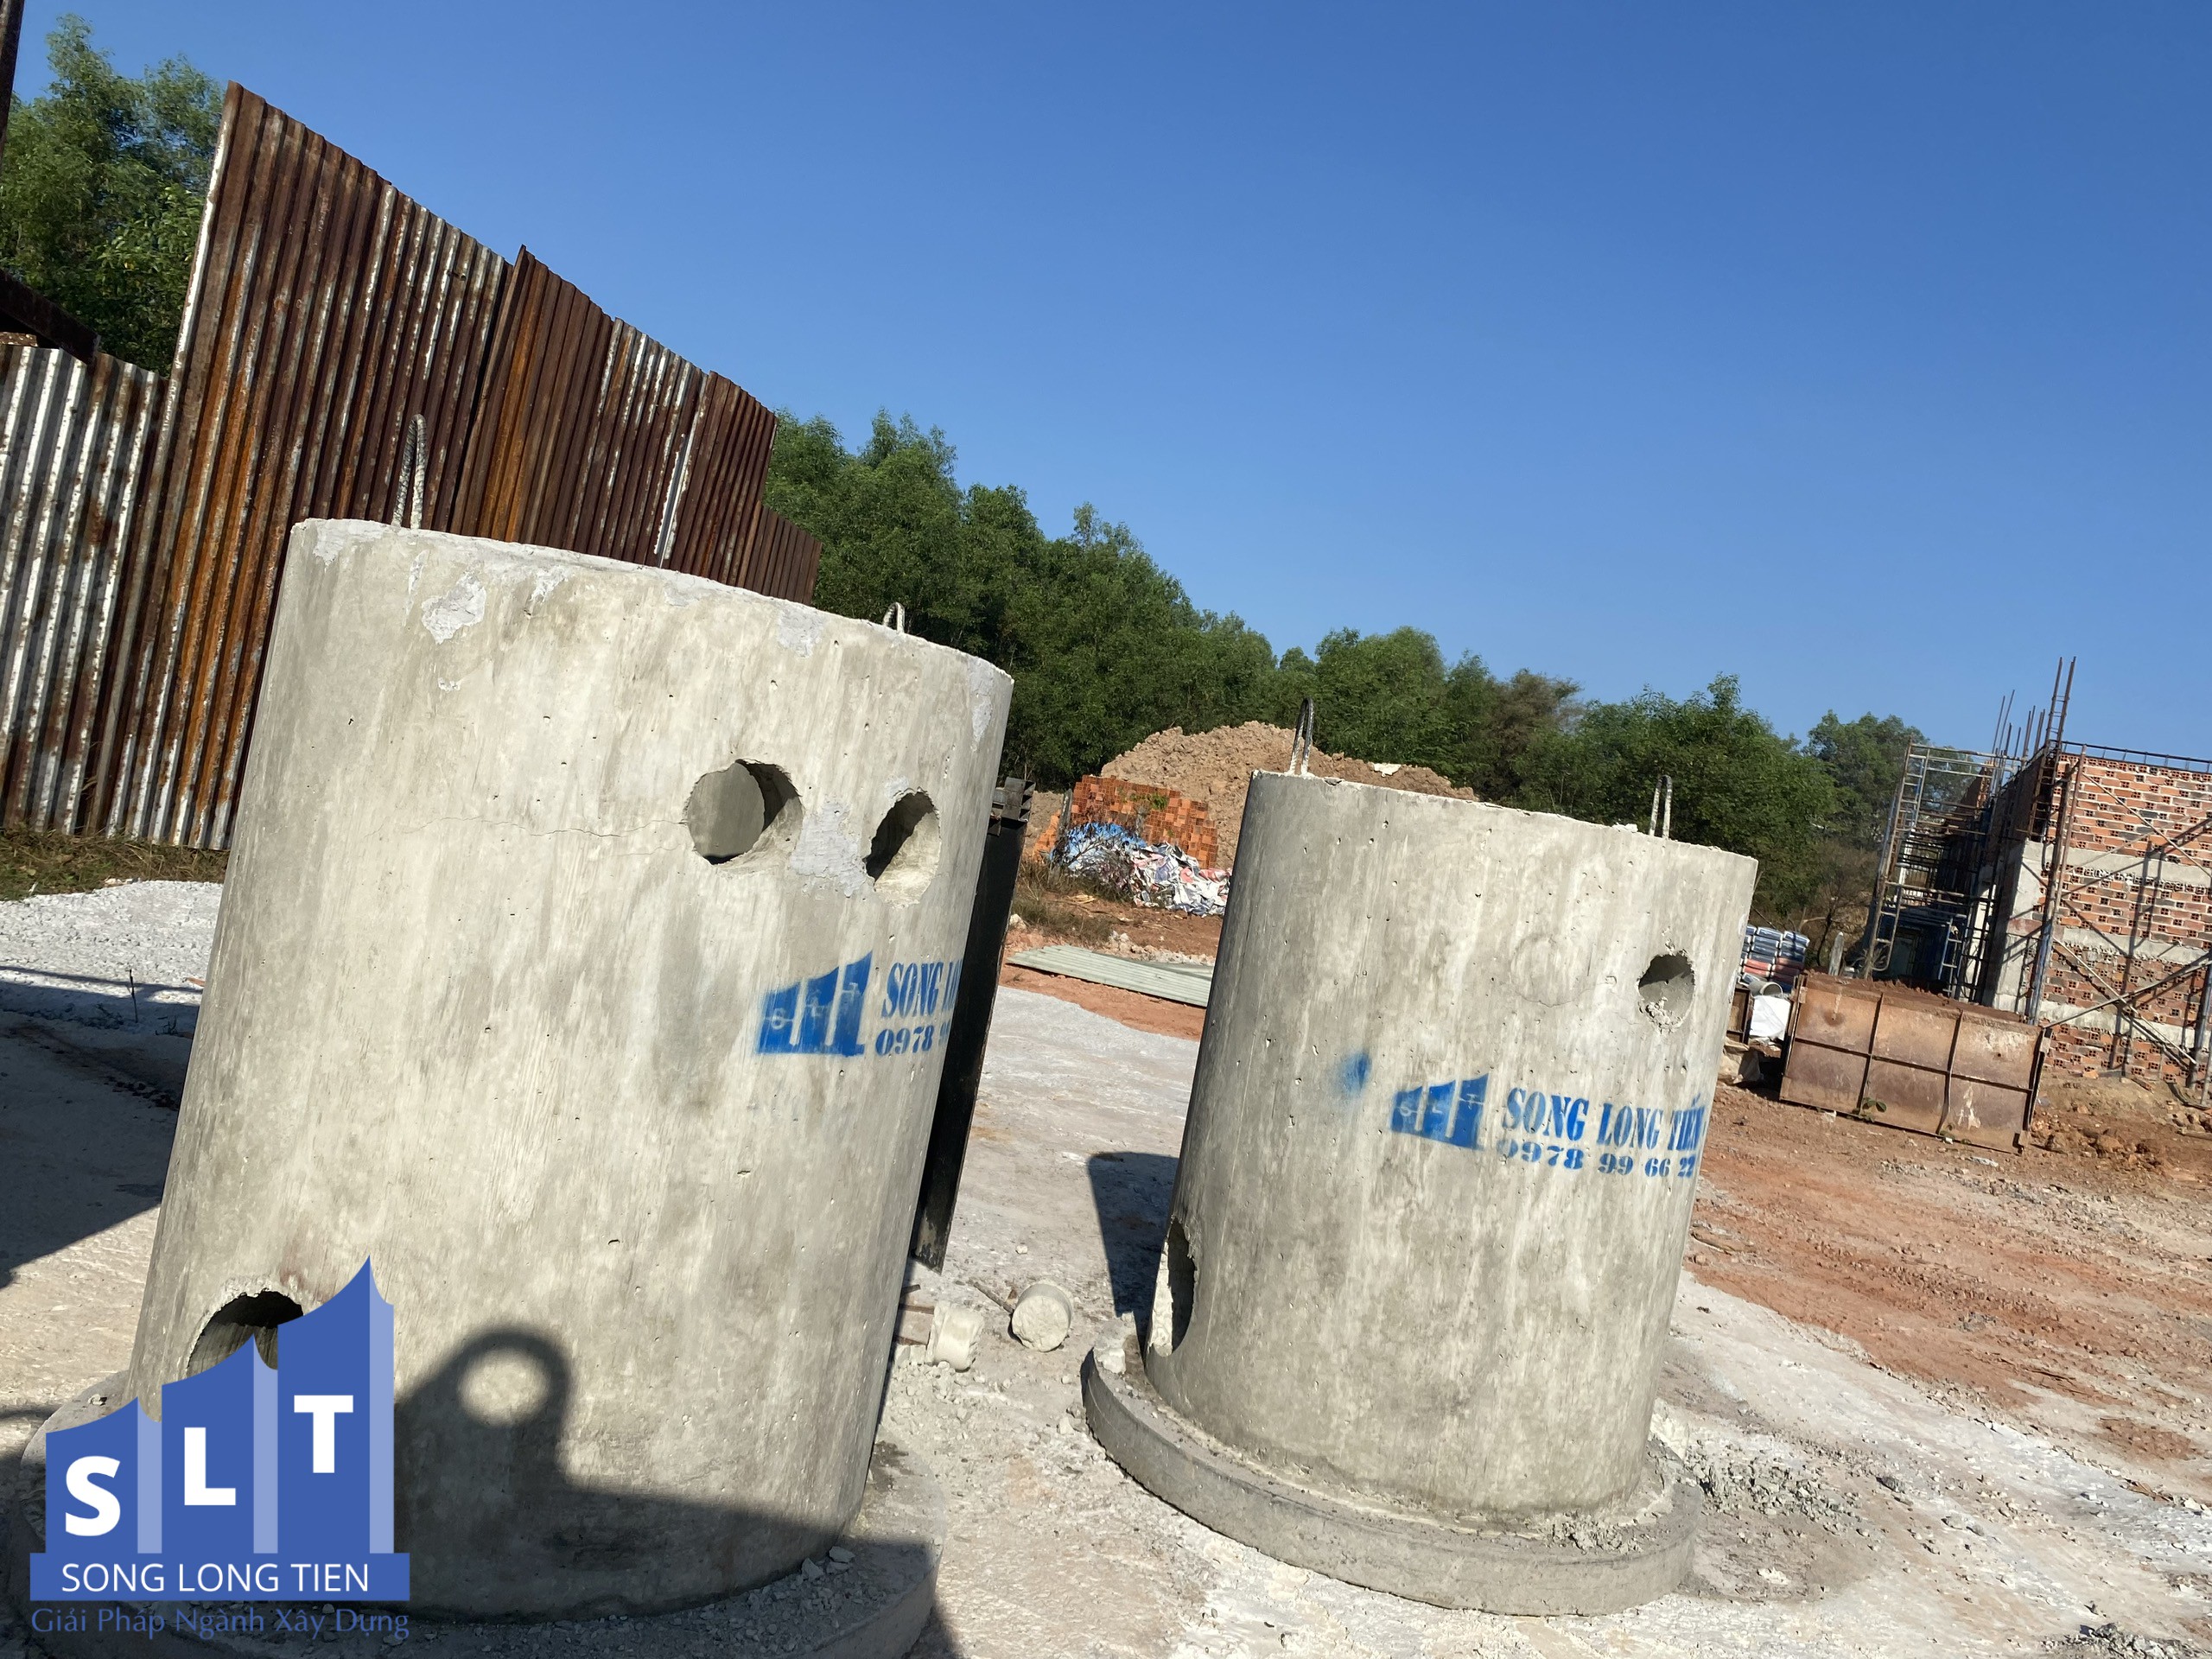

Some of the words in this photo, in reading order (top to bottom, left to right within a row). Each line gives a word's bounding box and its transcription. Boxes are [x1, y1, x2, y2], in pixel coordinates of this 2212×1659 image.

[880, 961, 944, 1019] SONG
[875, 1025, 935, 1056] 0978
[1502, 1087, 1590, 1141] SONG
[1597, 1103, 1663, 1150] LONG
[1496, 1138, 1585, 1170] 0978
[1598, 1152, 1634, 1176] 99
[1644, 1158, 1671, 1178] 66
